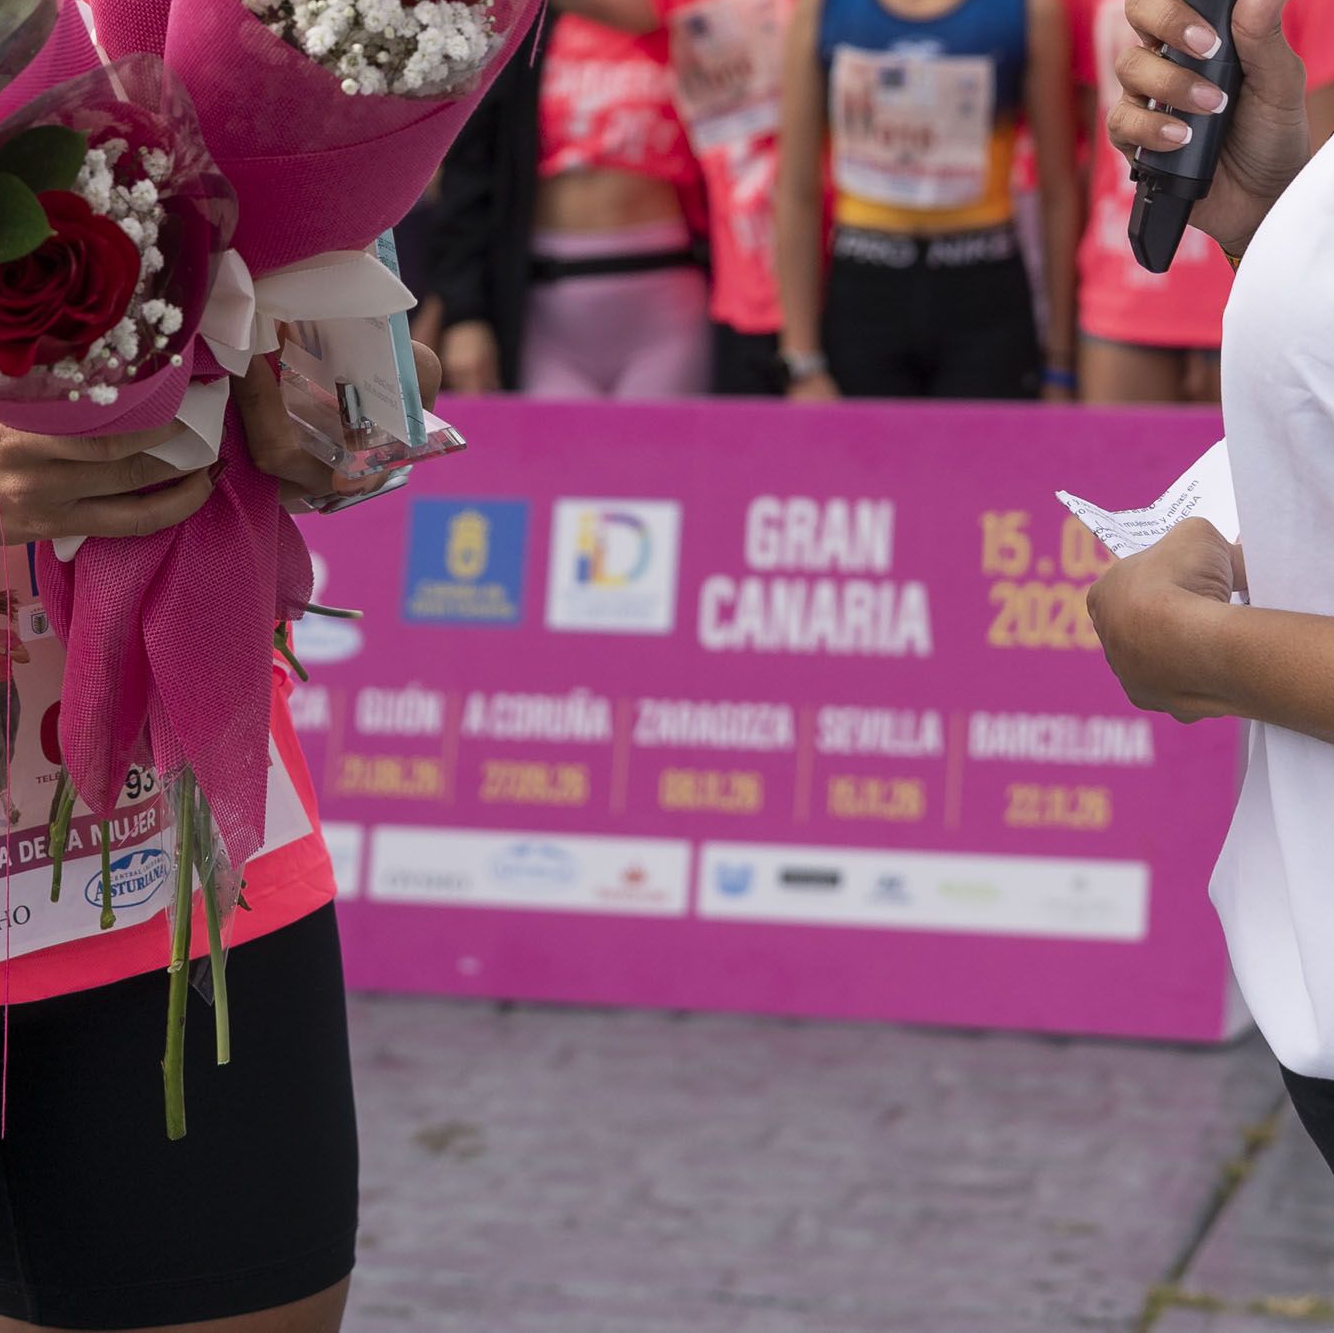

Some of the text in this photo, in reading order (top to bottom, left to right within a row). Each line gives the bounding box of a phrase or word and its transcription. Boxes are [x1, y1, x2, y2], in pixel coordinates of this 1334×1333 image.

[1187, 479, 1200, 492] en
[745, 496, 894, 573] GRAN
[697, 575, 932, 657] CANARIA
[634, 698, 795, 751] ZARAGOZA
[816, 706, 943, 757] SEVILLA
[969, 712, 1154, 766] BARCELONA
[18, 836, 47, 864] DE
[90, 808, 156, 847] MUJER
